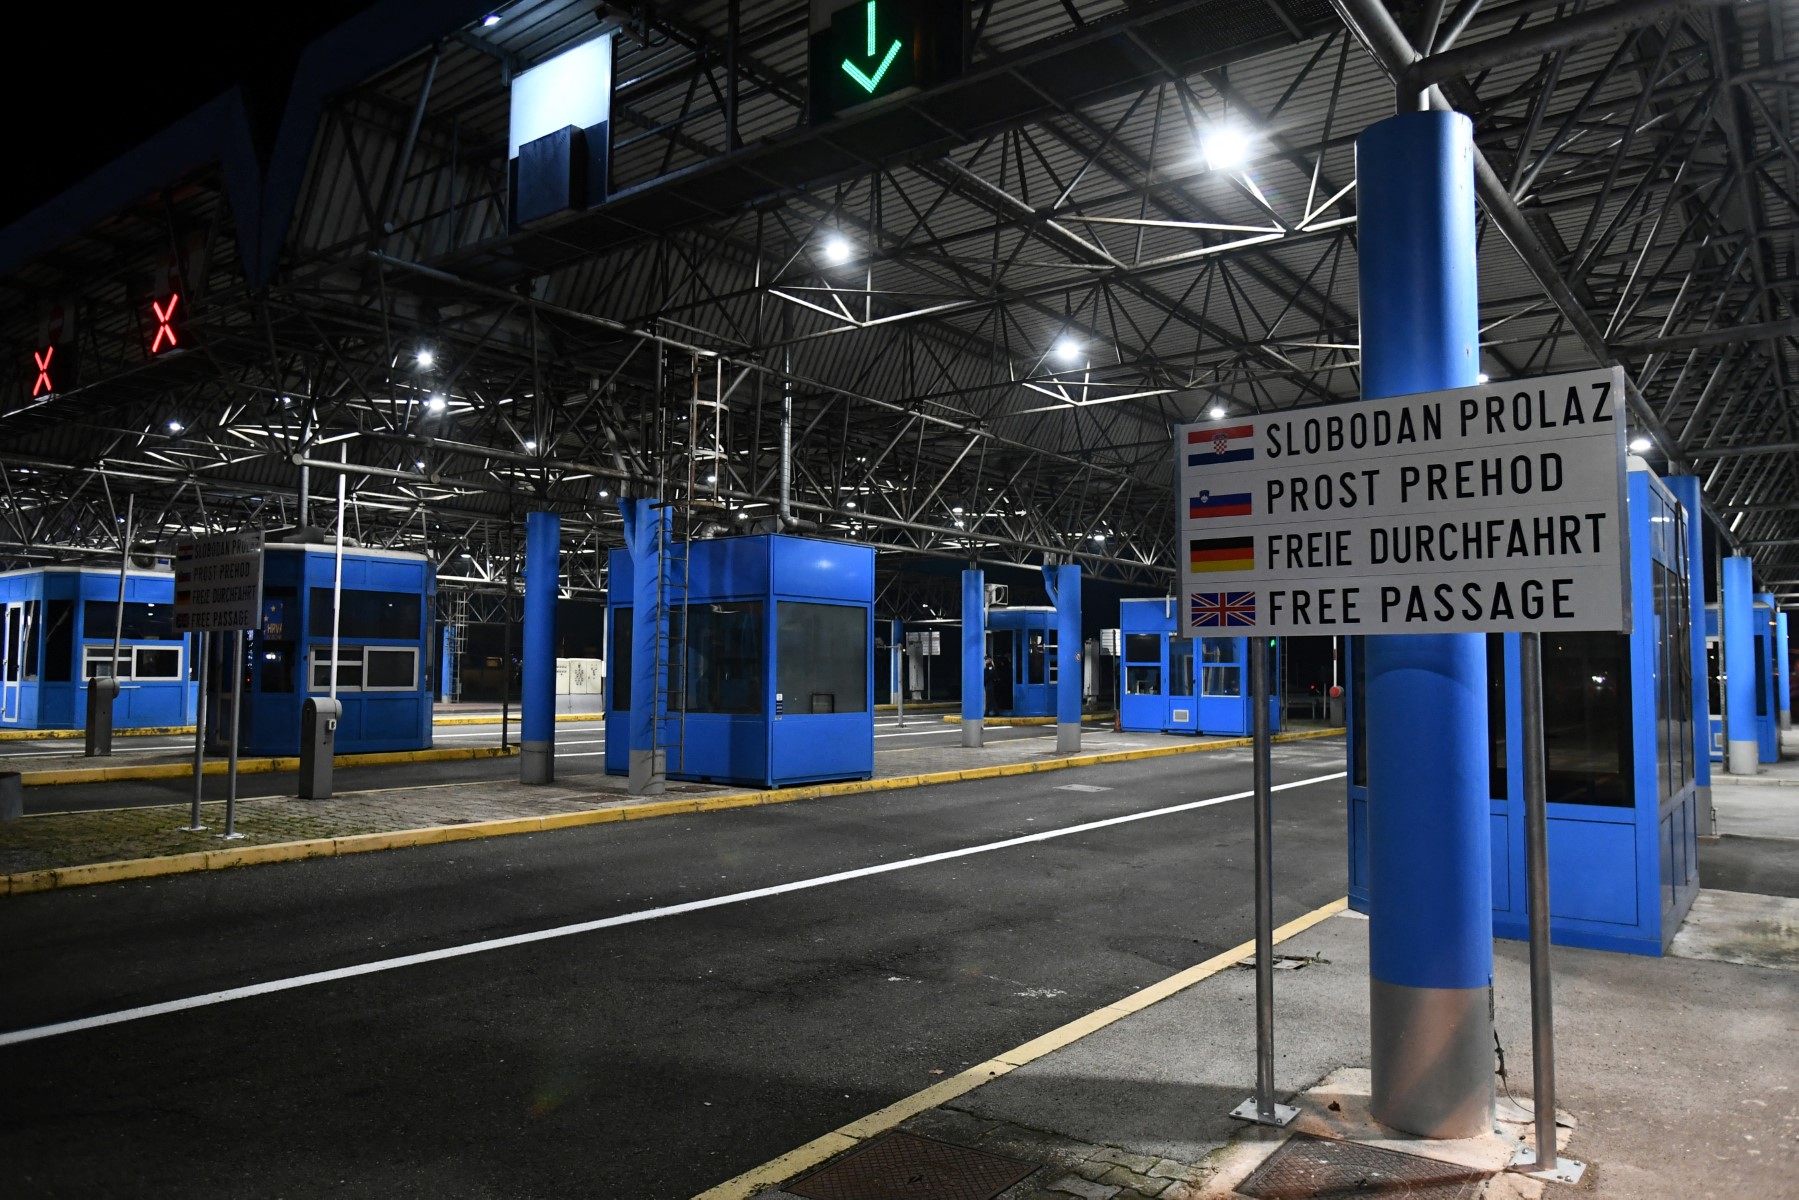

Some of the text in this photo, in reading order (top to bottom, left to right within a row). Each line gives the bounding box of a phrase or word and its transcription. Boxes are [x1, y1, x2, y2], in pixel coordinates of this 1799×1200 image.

[1266, 381, 1613, 459] SLOBODAN PROLAZ
[1267, 452, 1563, 514] PROST PREHOD
[194, 542, 230, 559] SLOBODAN
[1268, 512, 1606, 569] FREIE DURCHFAHRT
[193, 562, 250, 582] PROST PREHOD
[192, 585, 256, 605] FREIE DURCHFAHRT
[1269, 578, 1575, 625] FREE PASSAGE
[191, 609, 249, 628] FREE PASSAGE
